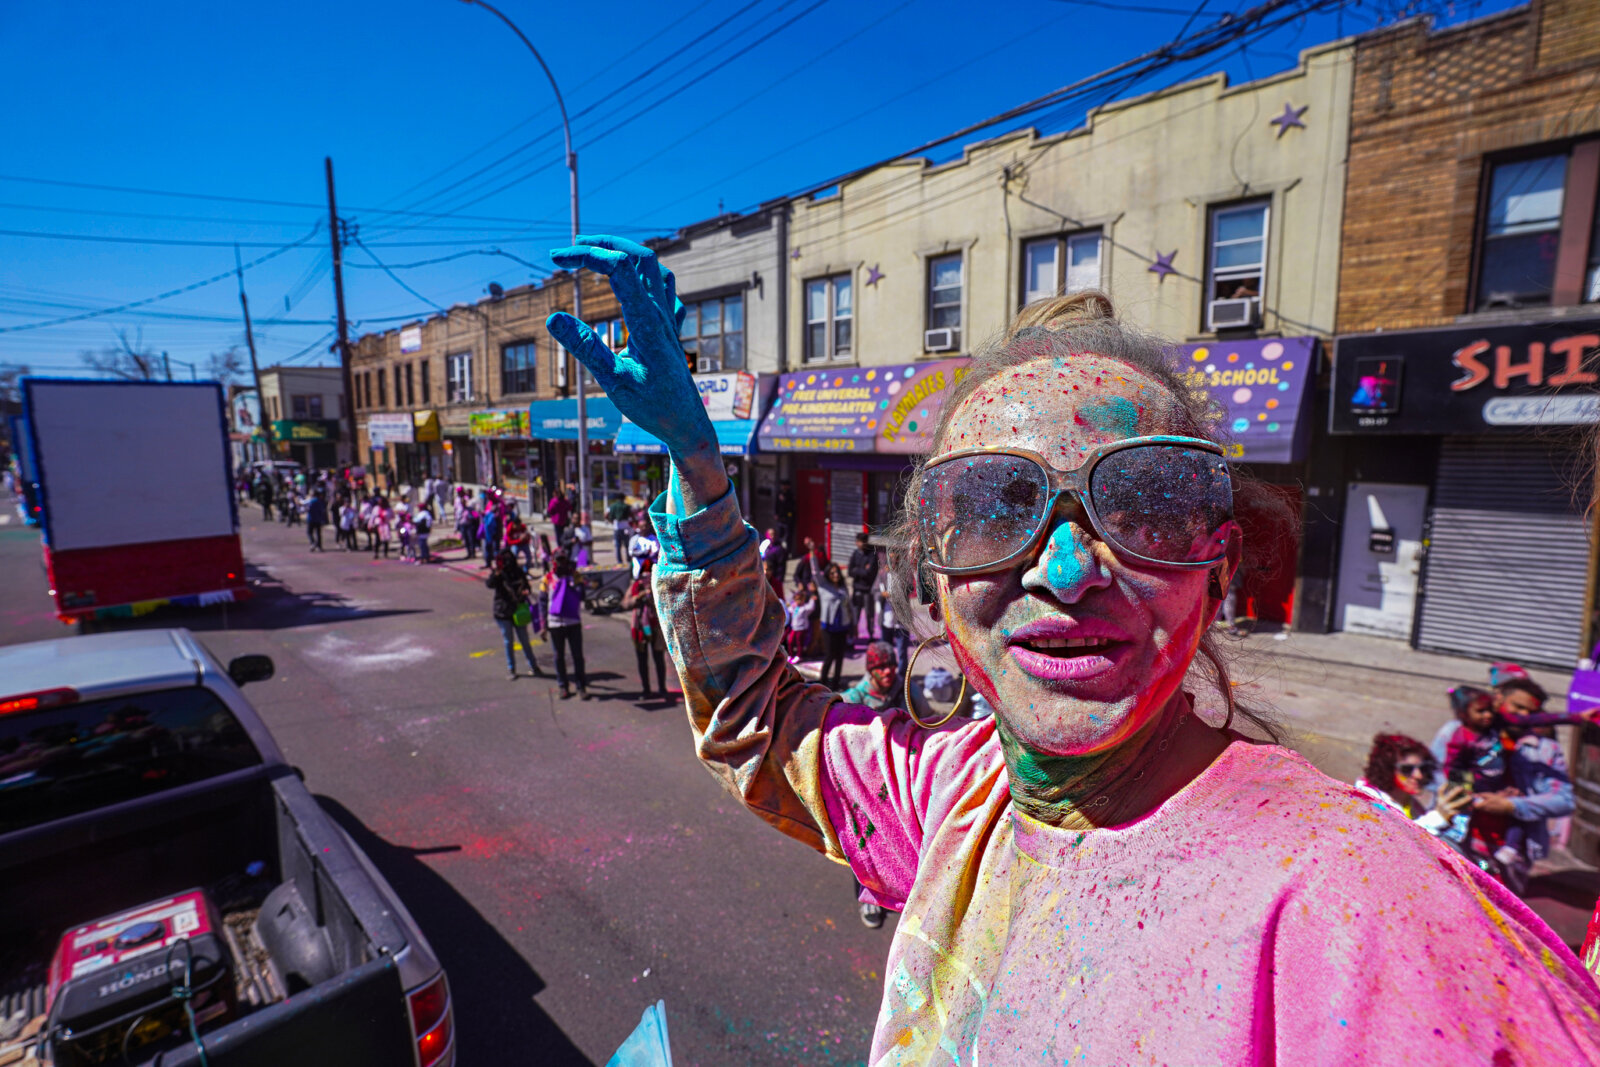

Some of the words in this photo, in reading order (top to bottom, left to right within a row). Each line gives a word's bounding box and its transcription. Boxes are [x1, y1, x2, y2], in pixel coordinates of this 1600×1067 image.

[1210, 368, 1280, 387] SCHOOL
[696, 378, 729, 394] ORLD
[792, 389, 816, 401] FREE
[816, 387, 871, 401] UNIVERSAL
[781, 401, 877, 414] PRE-KINDERGARTEN
[882, 370, 946, 443] PLAYMATES
[773, 438, 855, 450] 718-845-4973
[99, 959, 185, 998] HONDA
